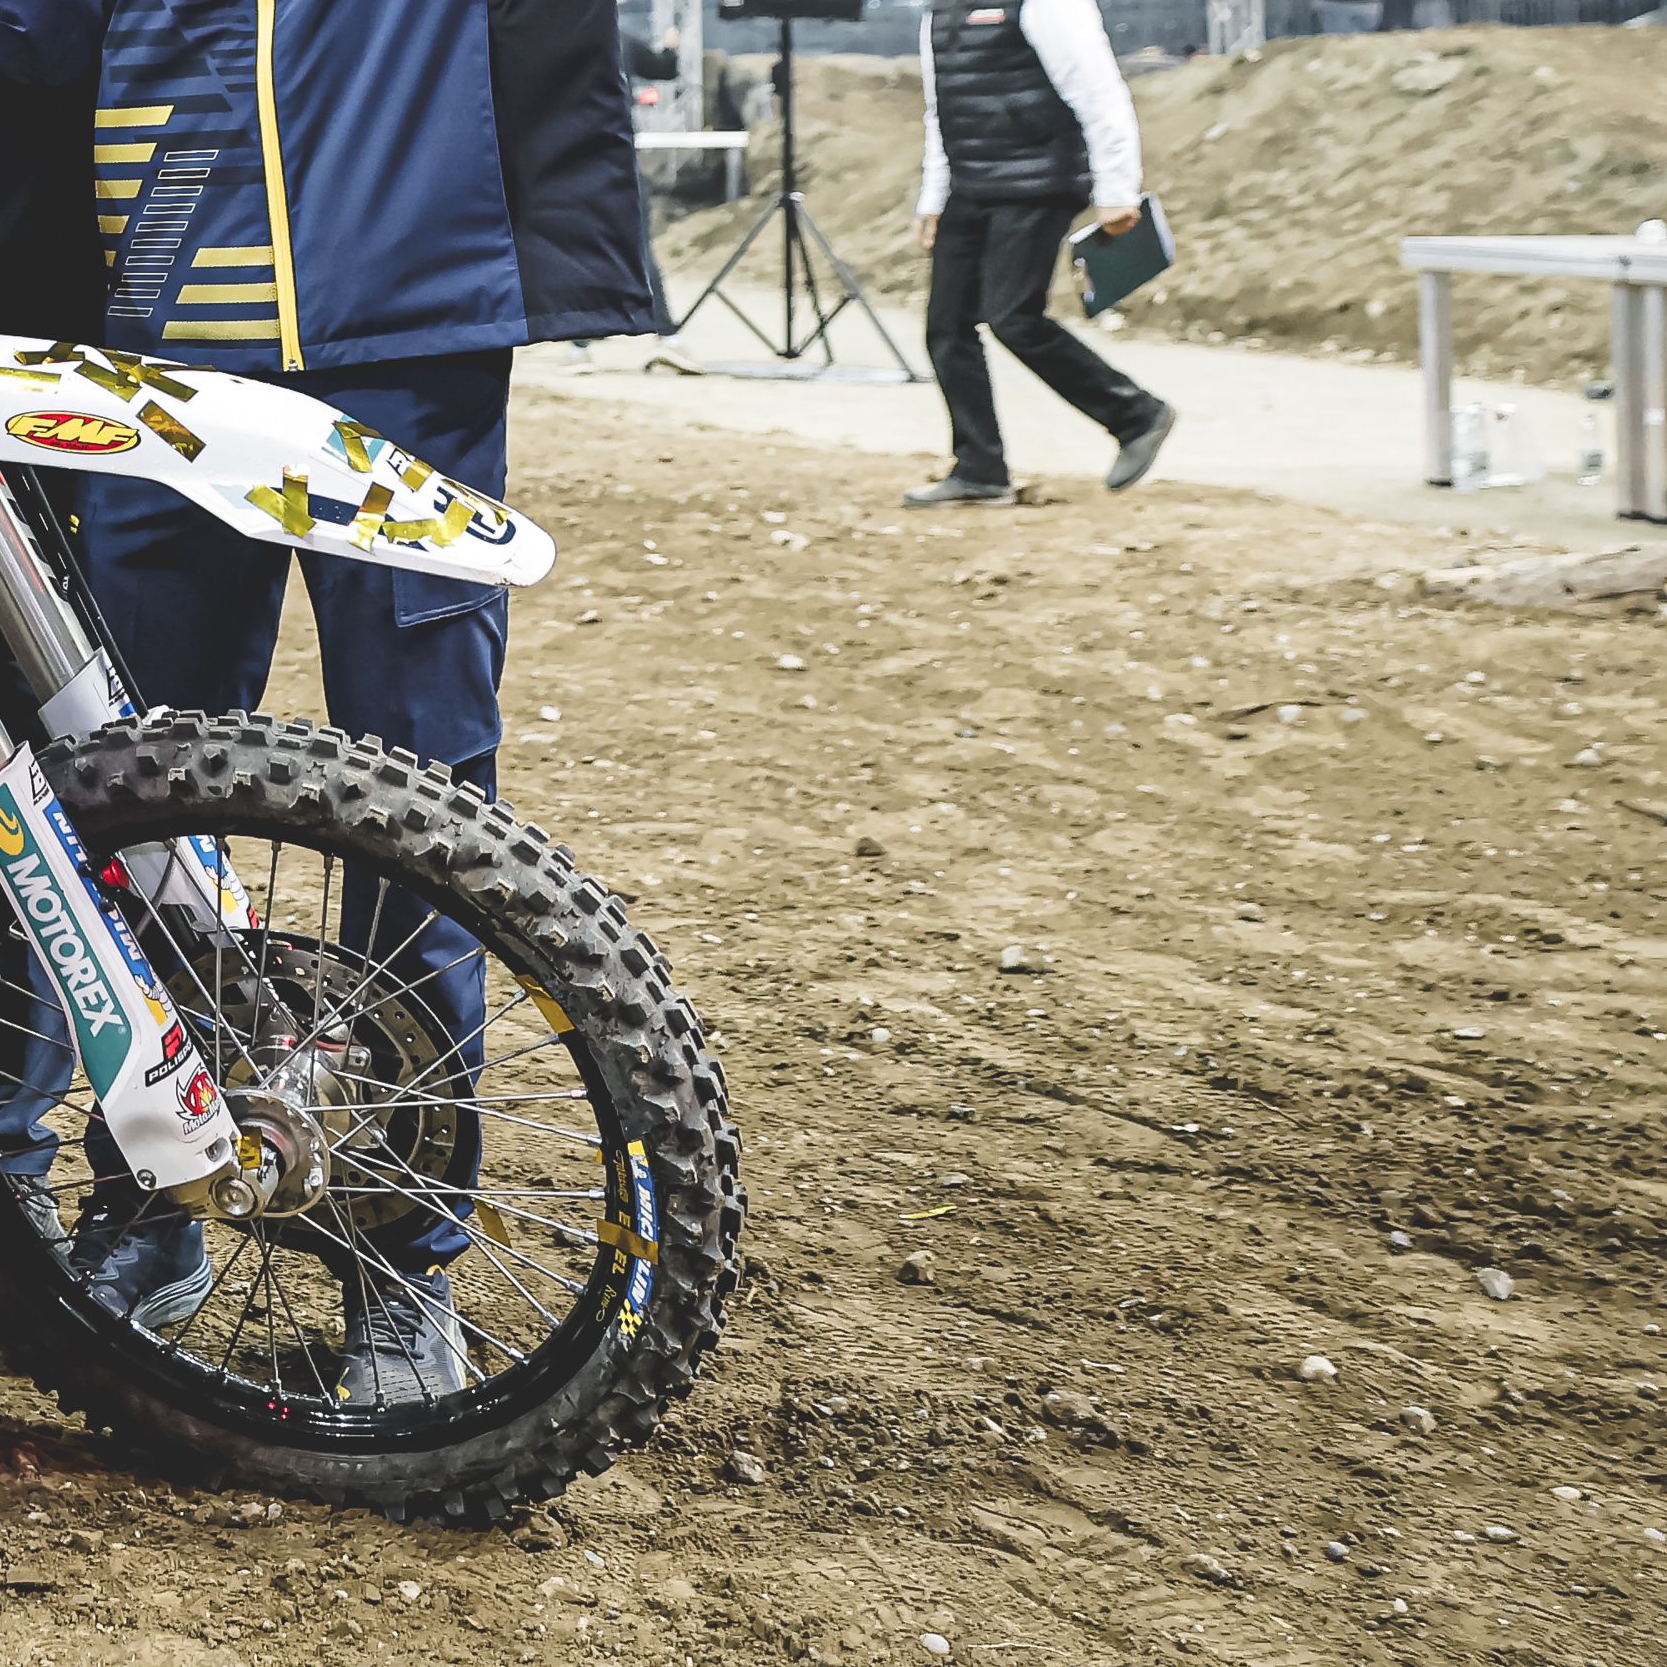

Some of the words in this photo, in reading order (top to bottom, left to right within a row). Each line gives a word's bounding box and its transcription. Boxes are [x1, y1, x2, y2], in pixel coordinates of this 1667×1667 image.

[9, 415, 139, 446] FMF
[7, 861, 122, 1038] MOTOREX
[612, 1209, 632, 1275] EEL
